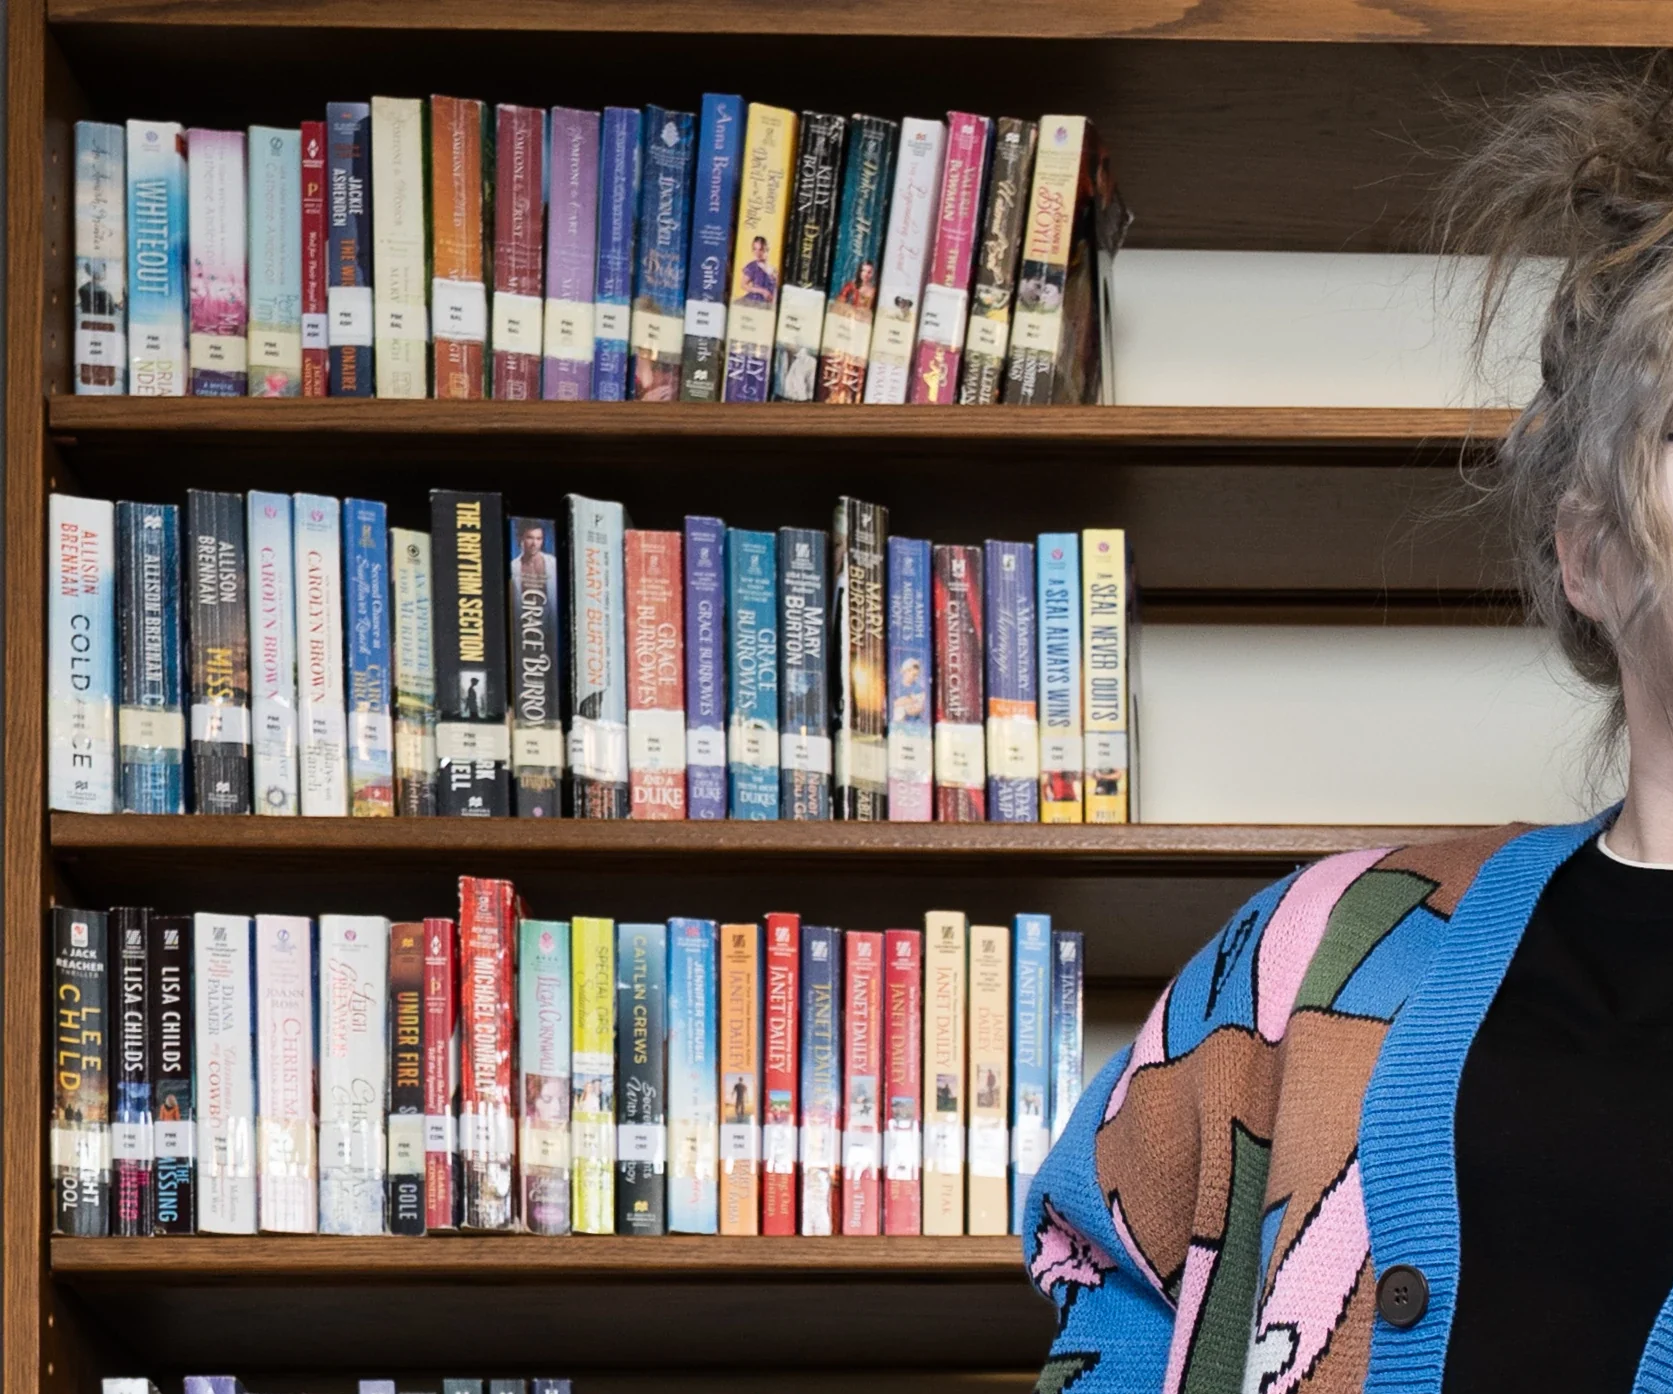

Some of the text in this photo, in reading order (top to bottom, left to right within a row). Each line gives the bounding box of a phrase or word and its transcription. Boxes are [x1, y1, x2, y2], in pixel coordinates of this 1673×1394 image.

[714, 104, 732, 149] Anna
[332, 168, 346, 226] ASHENDEN
[348, 177, 362, 214] JACKIE
[709, 156, 729, 212] Bennett
[135, 180, 169, 297] WHITEOUT
[61, 523, 78, 597] BRENNAN
[81, 531, 99, 595] ALLISON
[198, 536, 217, 604] BRENNAN
[219, 542, 236, 602] ALLISON
[456, 502, 484, 661] THE RHYTHM SECTION
[71, 614, 90, 691] COLD
[307, 550, 325, 703] CAROLYN BROWN
[585, 548, 603, 685] MARY BURTON
[637, 605, 658, 705] BURROWES
[657, 623, 677, 685] GRACE
[1046, 589, 1070, 728] SEAL ALWAYS WINS
[1091, 584, 1118, 721] SEAL NEVER QUITS
[60, 984, 81, 1090] CHILD
[82, 1007, 101, 1070] LEE
[162, 966, 180, 1072] LISA CHILDS
[398, 992, 418, 1087] UNDER FIRE
[474, 957, 498, 1095] MICHAEL CONNELLY
[633, 935, 647, 1064] CAITLIN CREWS
[769, 965, 785, 1073] JANET DAILEY
